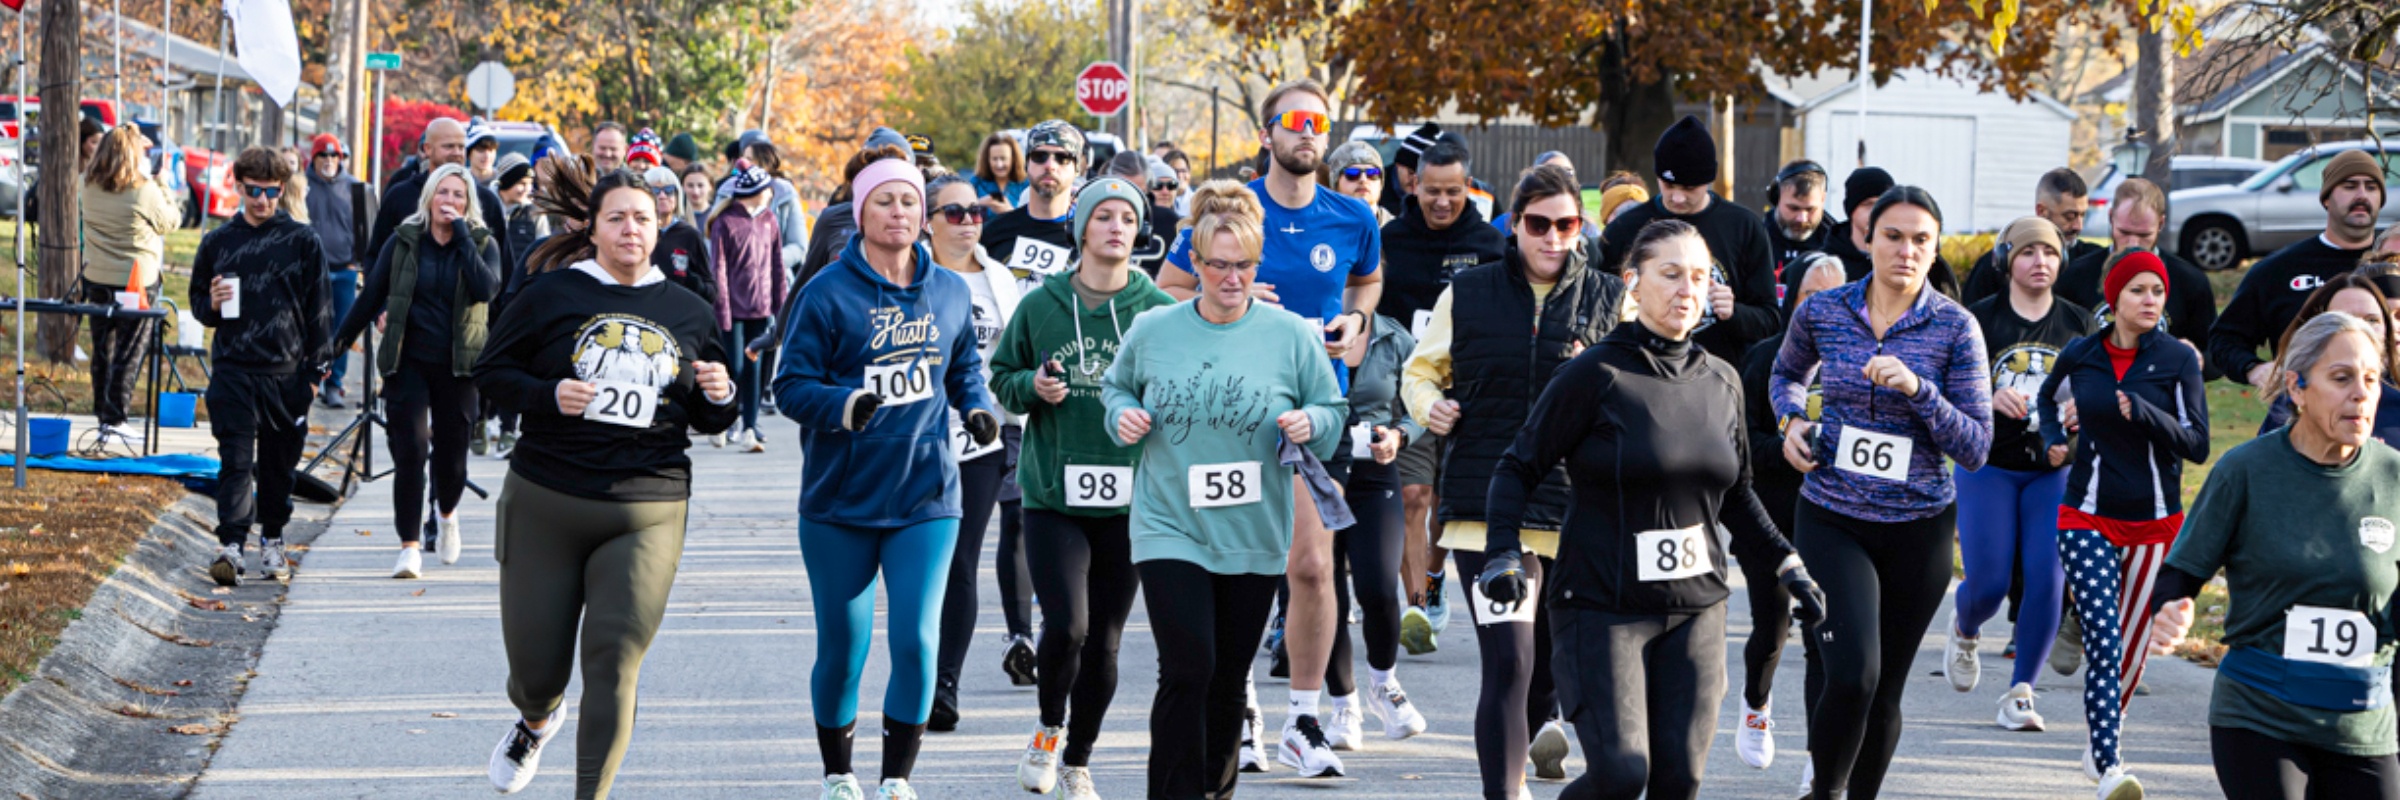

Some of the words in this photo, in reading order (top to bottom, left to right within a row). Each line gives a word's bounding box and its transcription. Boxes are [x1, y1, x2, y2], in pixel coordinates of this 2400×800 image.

[1079, 78, 1127, 100] STOP
[1022, 244, 1055, 269] 99
[871, 311, 940, 350] Hustle
[1052, 336, 1096, 363] OUND
[871, 366, 925, 398] 100
[599, 386, 642, 419] 20
[1852, 437, 1894, 471] 66
[1079, 472, 1117, 500] 98
[1205, 470, 1246, 500] 58
[1656, 537, 1697, 572] 88
[2307, 617, 2358, 657] 19
